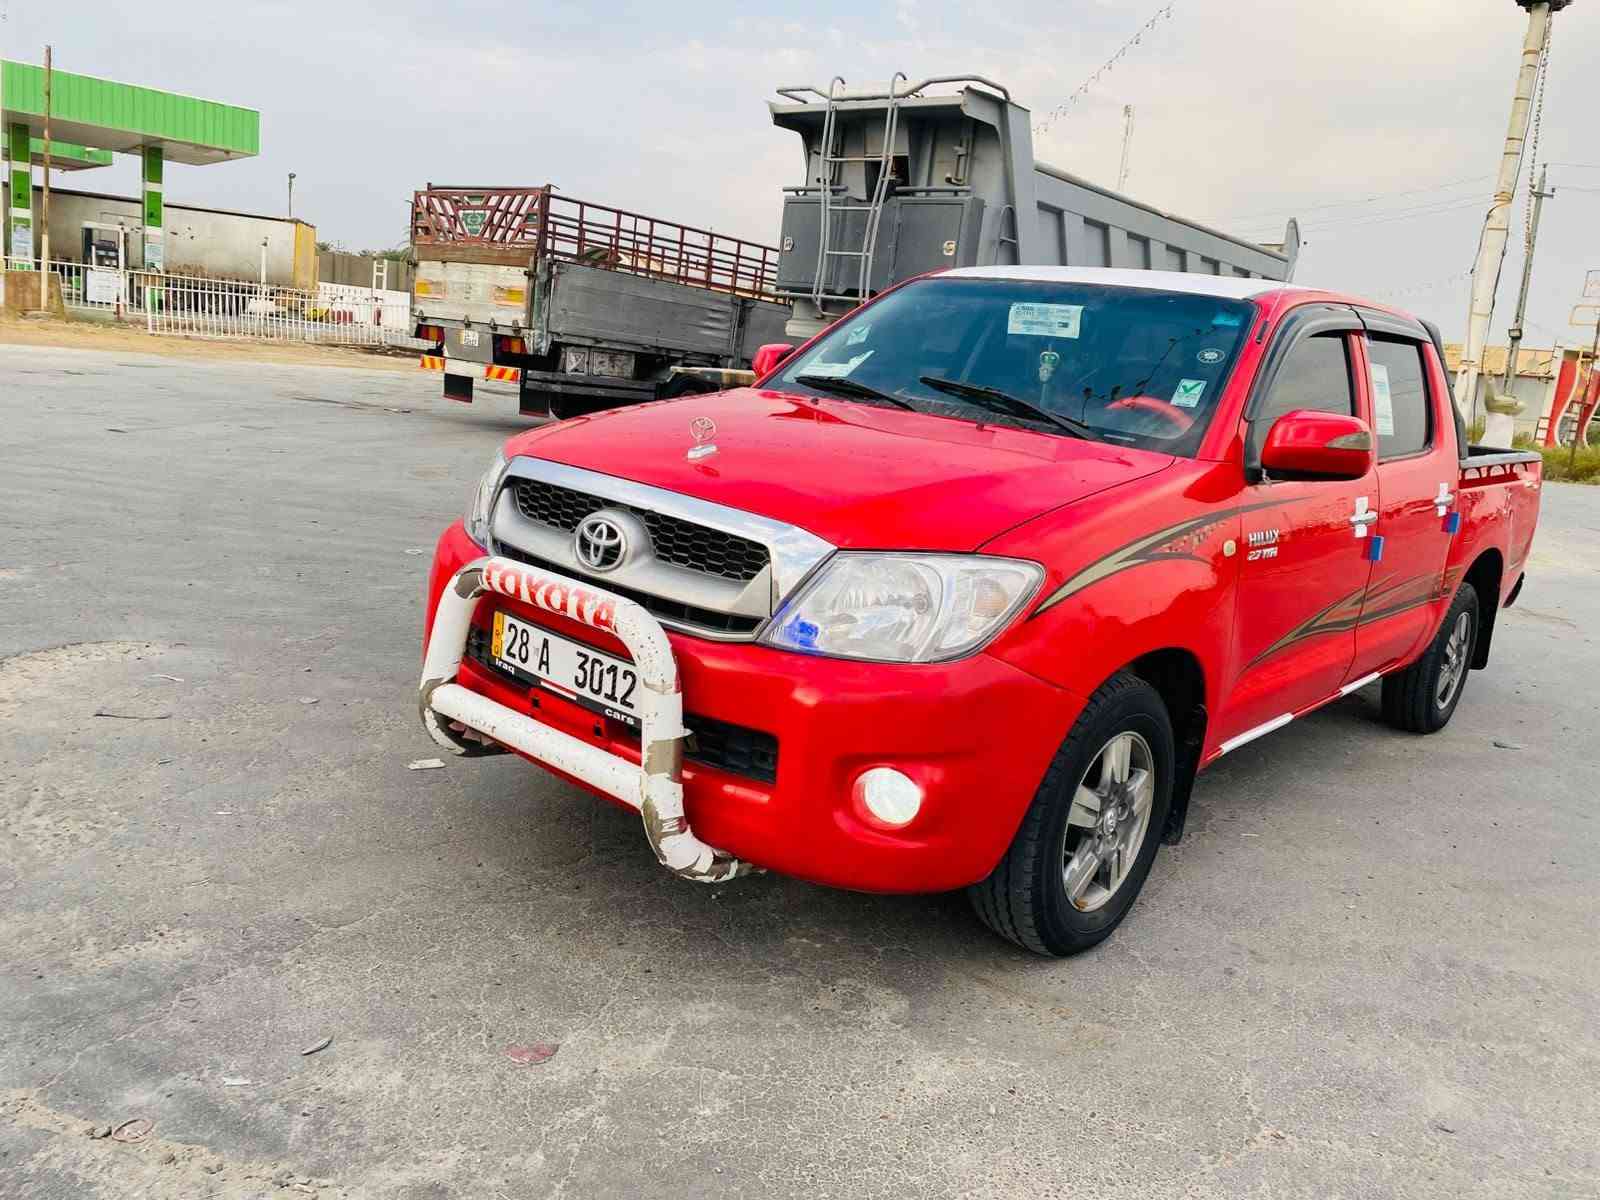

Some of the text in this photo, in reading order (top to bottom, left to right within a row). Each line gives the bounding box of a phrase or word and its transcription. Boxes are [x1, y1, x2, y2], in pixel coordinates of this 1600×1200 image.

[1248, 529, 1279, 547] HILUX
[485, 561, 616, 629] TOYOTA
[507, 623, 636, 709] 28 A 3012
